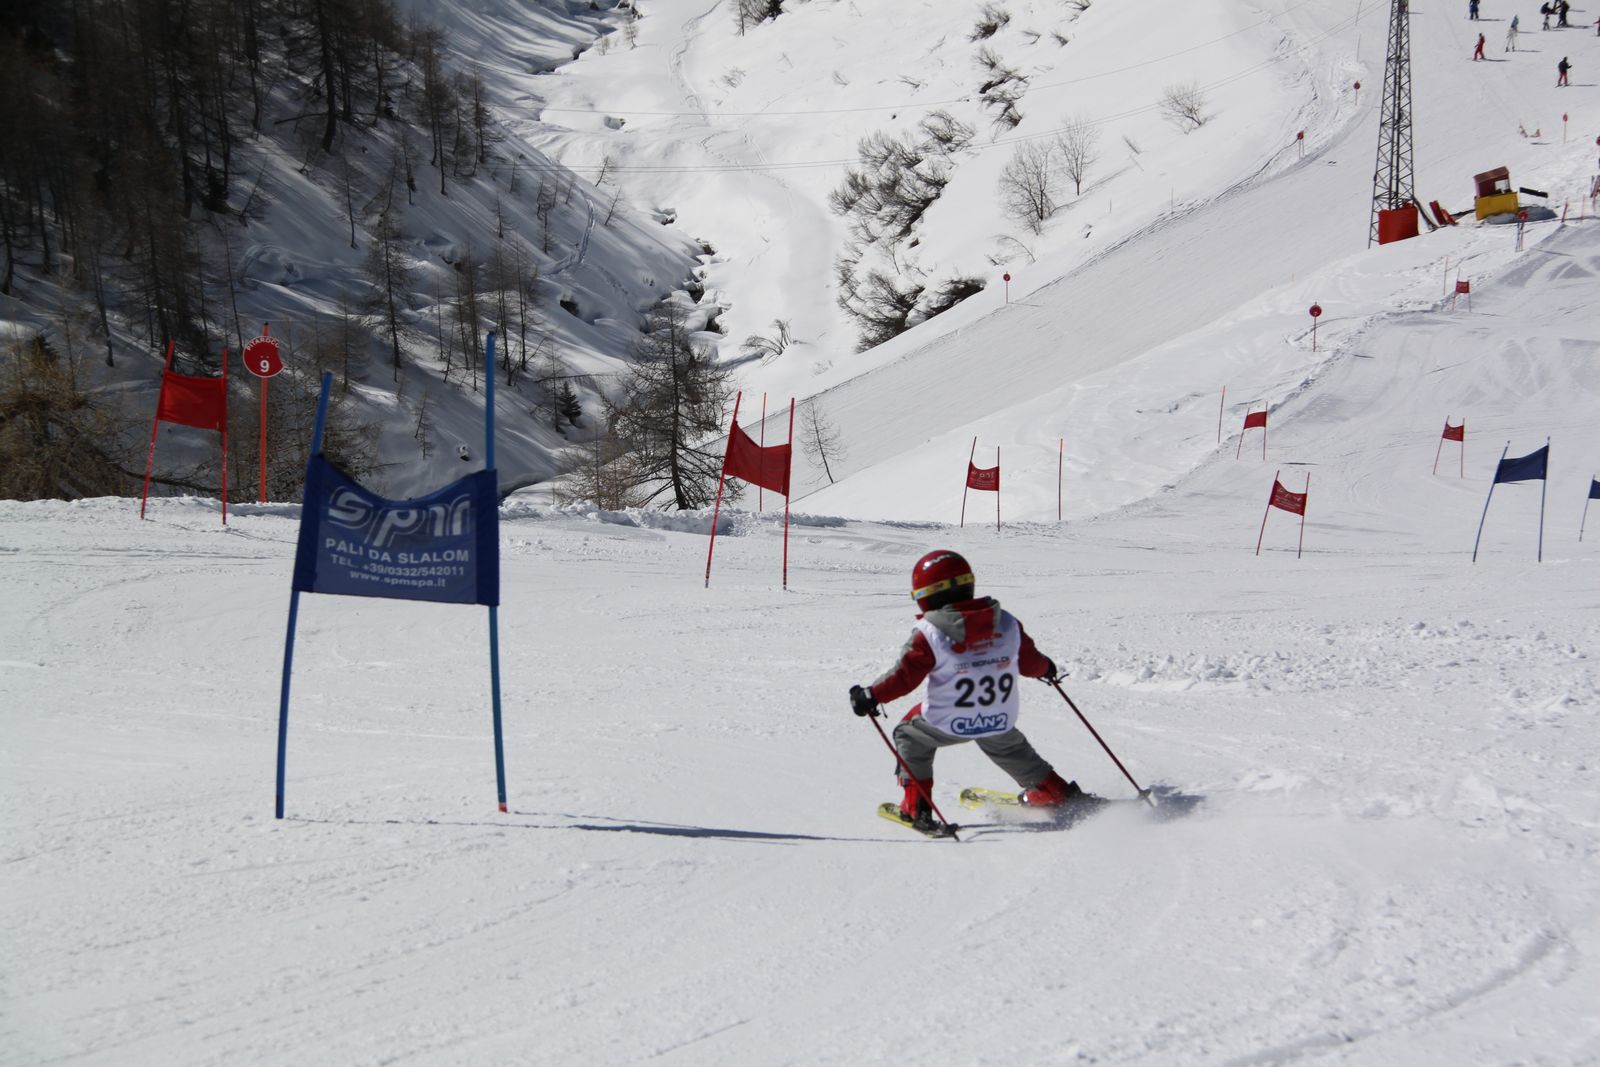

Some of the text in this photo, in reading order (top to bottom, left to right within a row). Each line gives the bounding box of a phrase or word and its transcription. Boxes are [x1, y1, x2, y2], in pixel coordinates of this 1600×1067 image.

[260, 360, 269, 373] 9
[325, 538, 469, 564] PALI DA SLALOM
[350, 570, 446, 587] www.spmspa.it
[362, 563, 464, 577] +39/0332/542011
[955, 673, 1013, 707] 239
